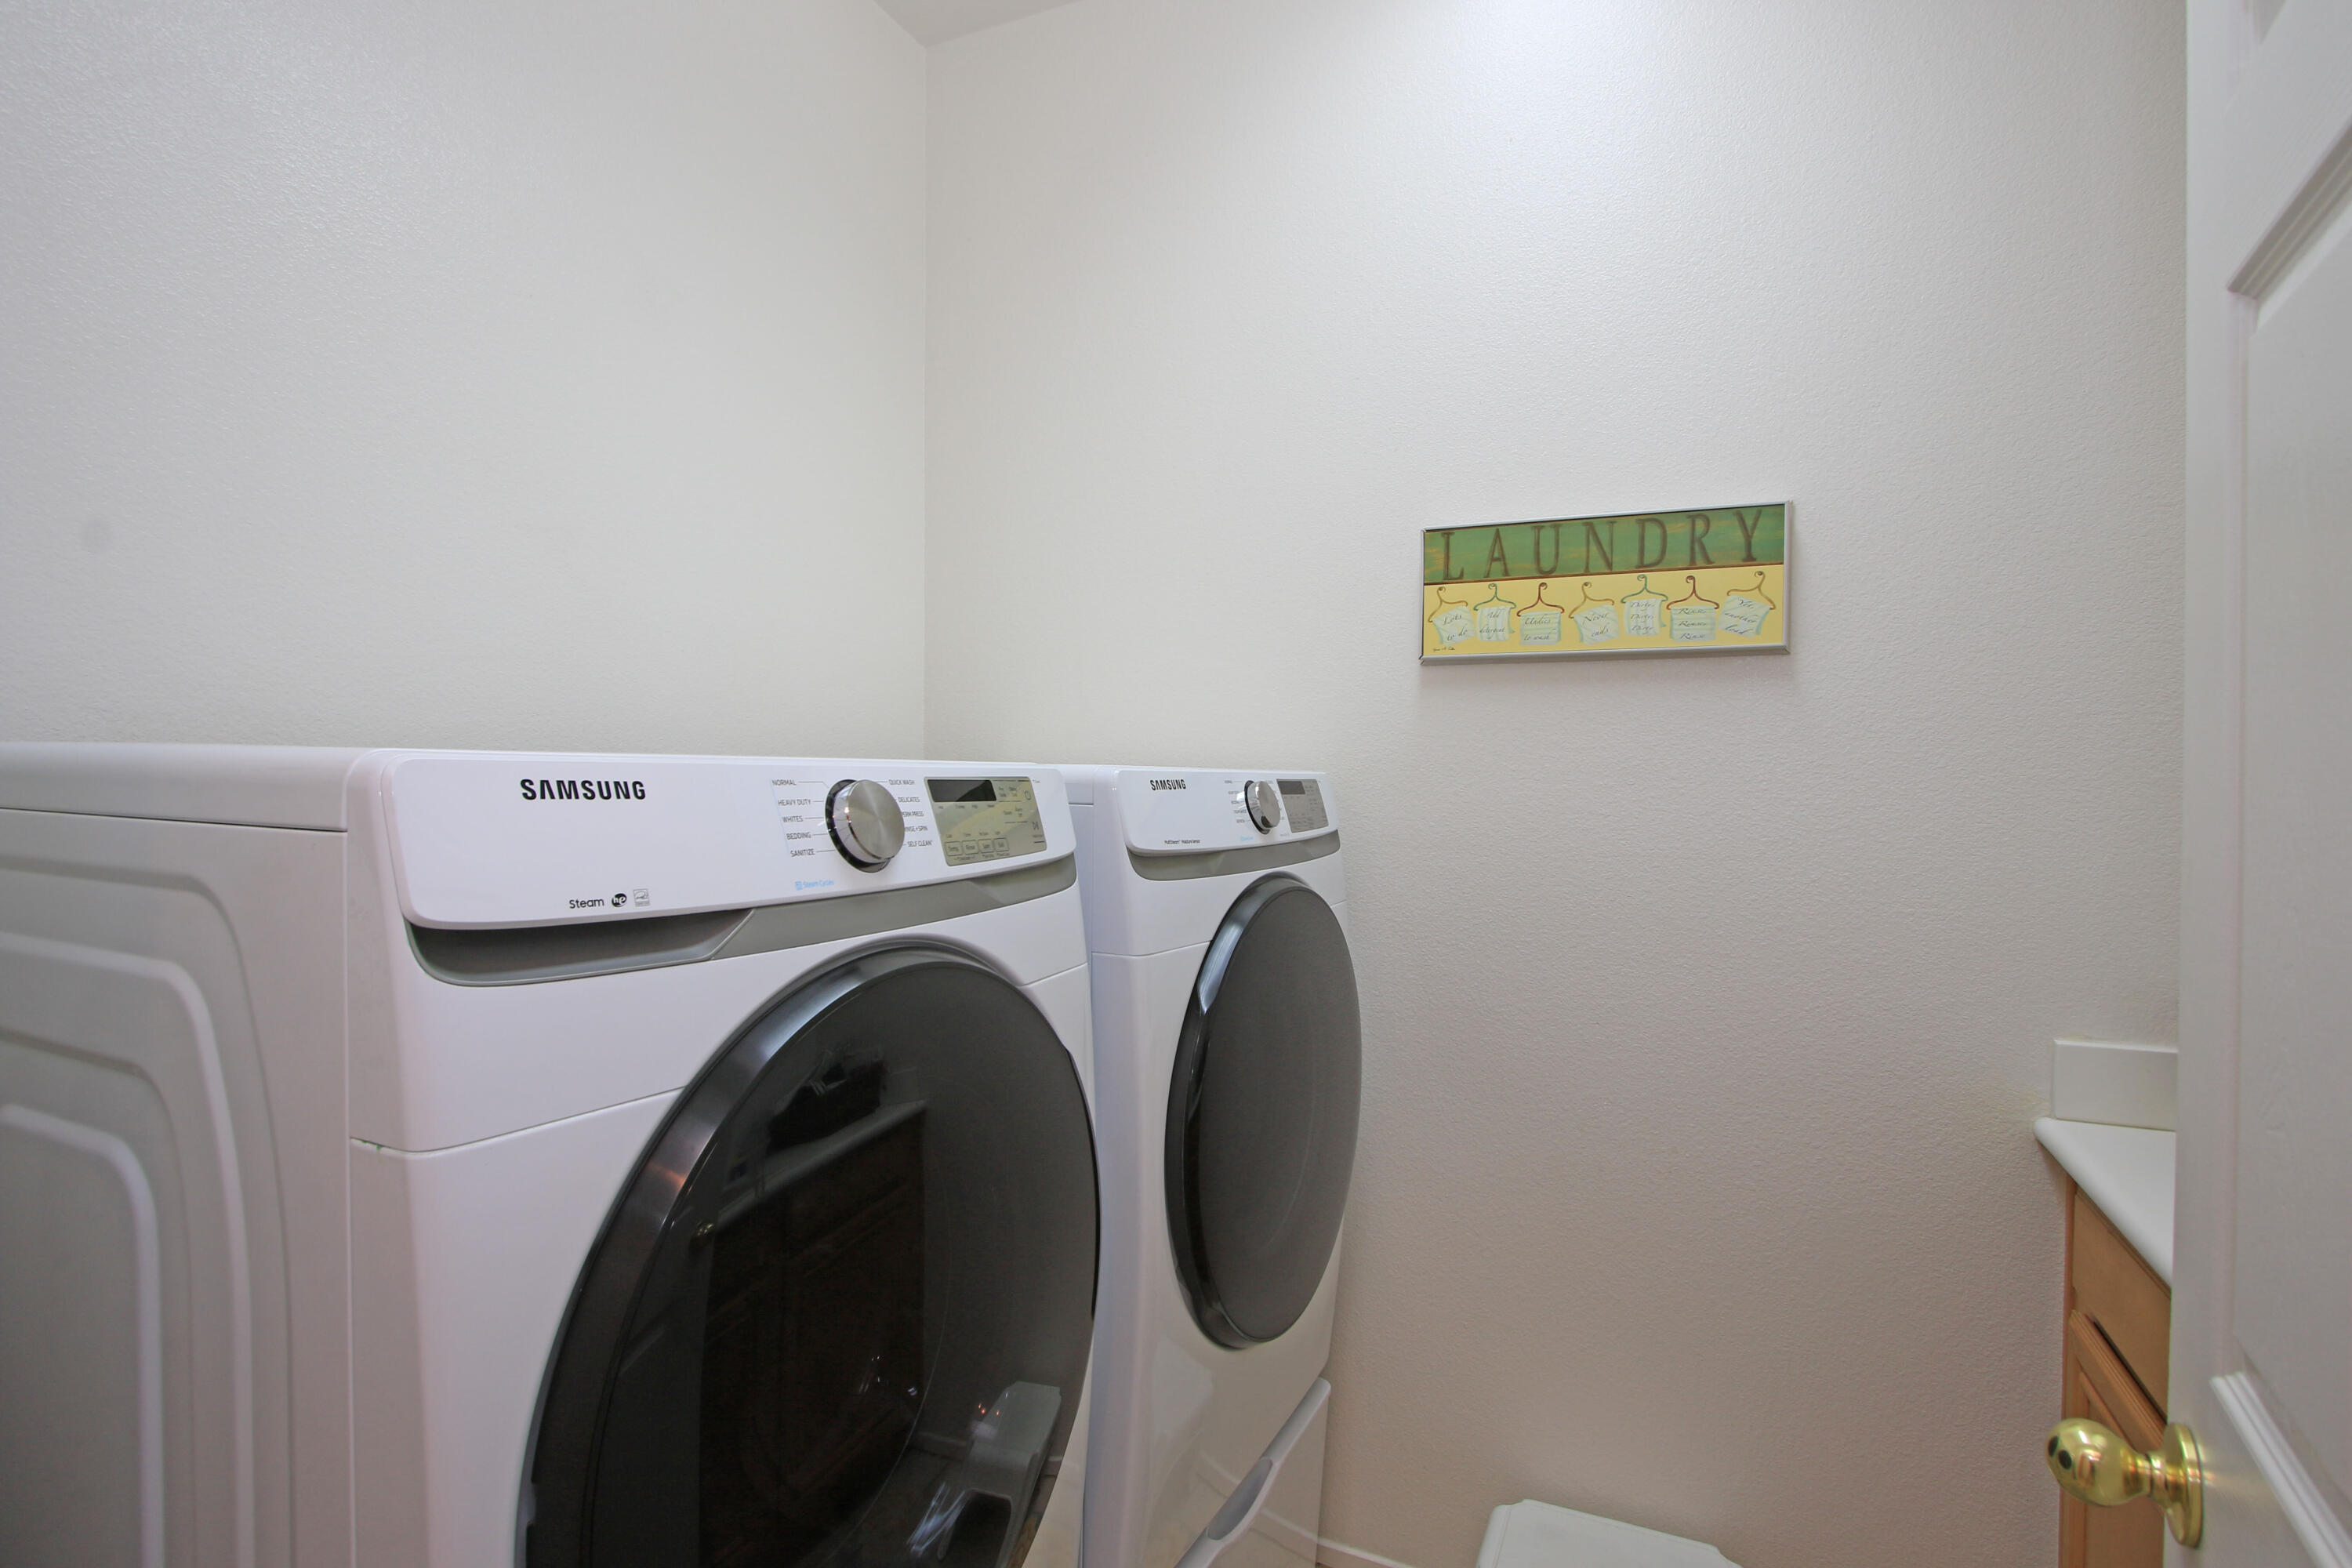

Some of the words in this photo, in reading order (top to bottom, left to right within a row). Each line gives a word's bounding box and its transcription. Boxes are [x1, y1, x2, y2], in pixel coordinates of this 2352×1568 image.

[1440, 510, 1762, 580] LAUNDRY
[520, 779, 646, 800] SAMSUNG
[1149, 779, 1186, 791] SAMSUNG
[790, 848, 815, 858] SANITIZE
[569, 898, 604, 909] Steam
